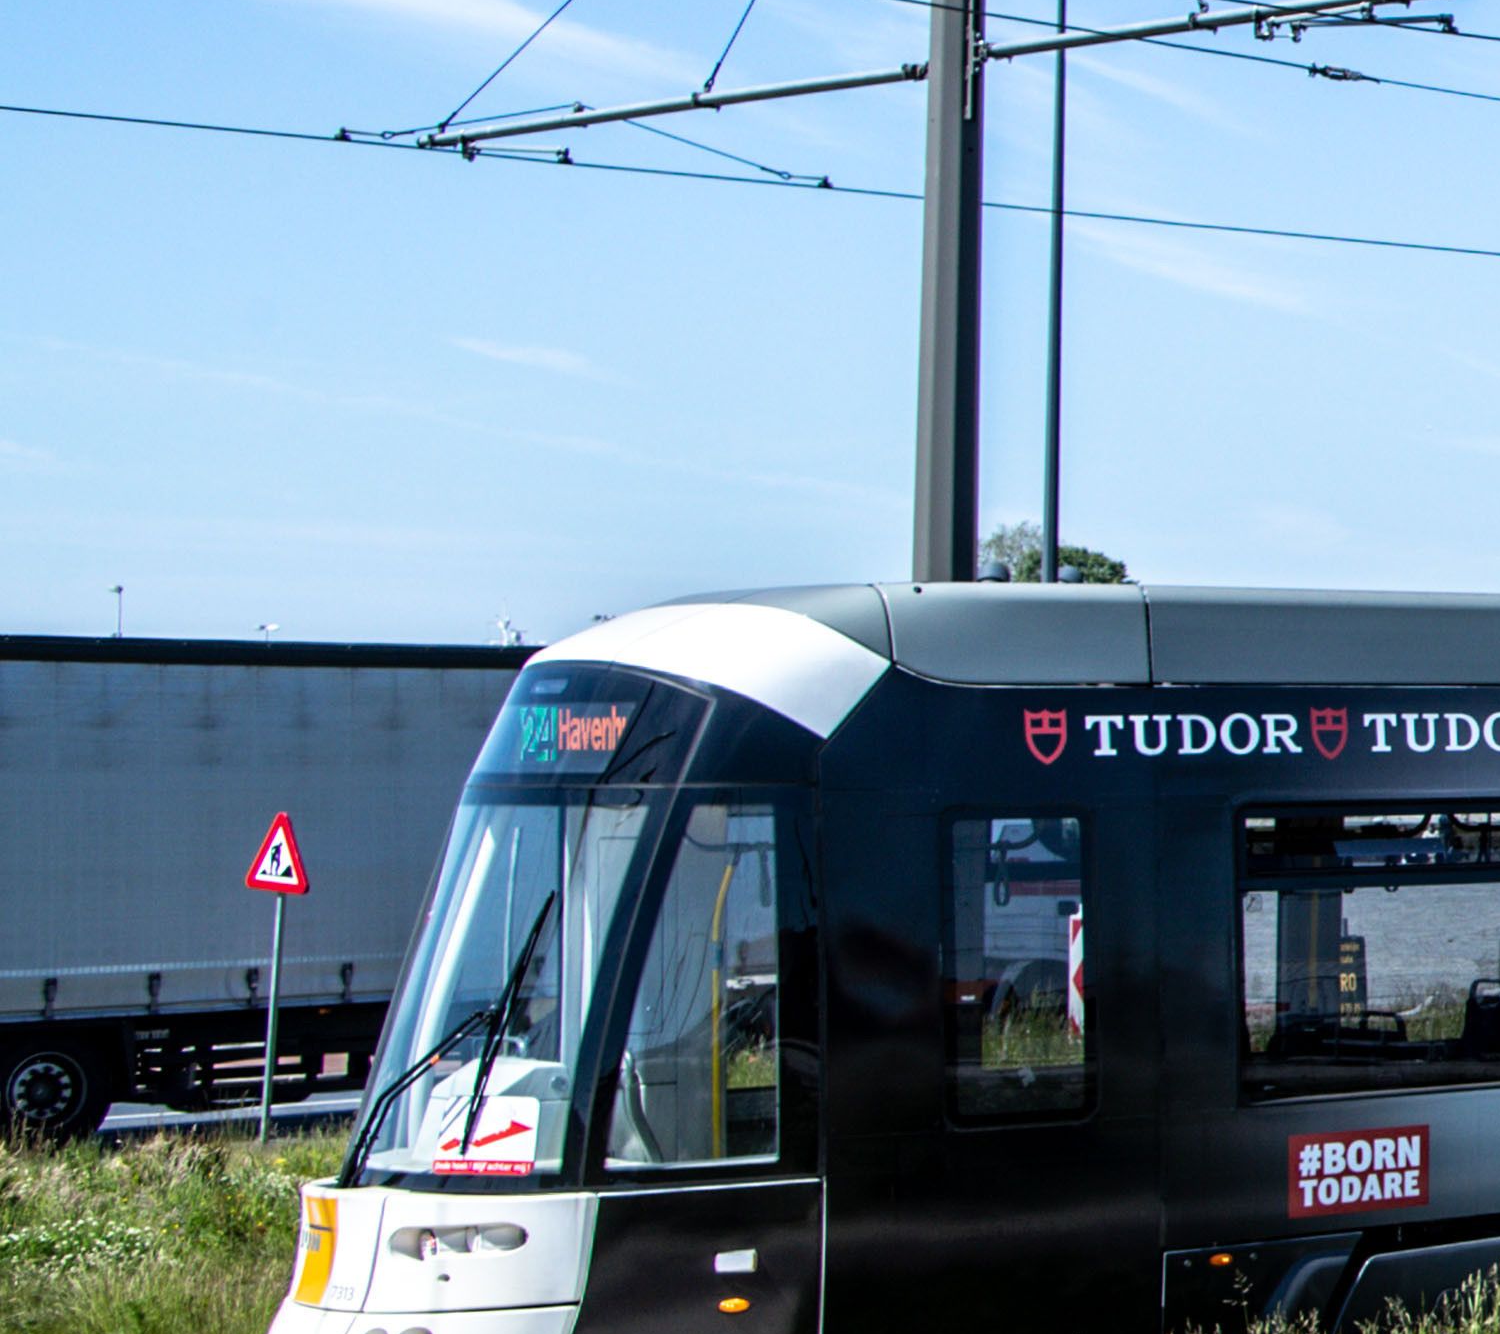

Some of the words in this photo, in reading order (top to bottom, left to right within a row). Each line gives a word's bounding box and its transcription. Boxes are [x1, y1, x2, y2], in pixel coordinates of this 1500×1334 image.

[521, 706, 557, 761] 24
[1085, 713, 1303, 756] TUDOR
[1299, 1134, 1421, 1177] #BORN
[1299, 1169, 1420, 1208] TODARE
